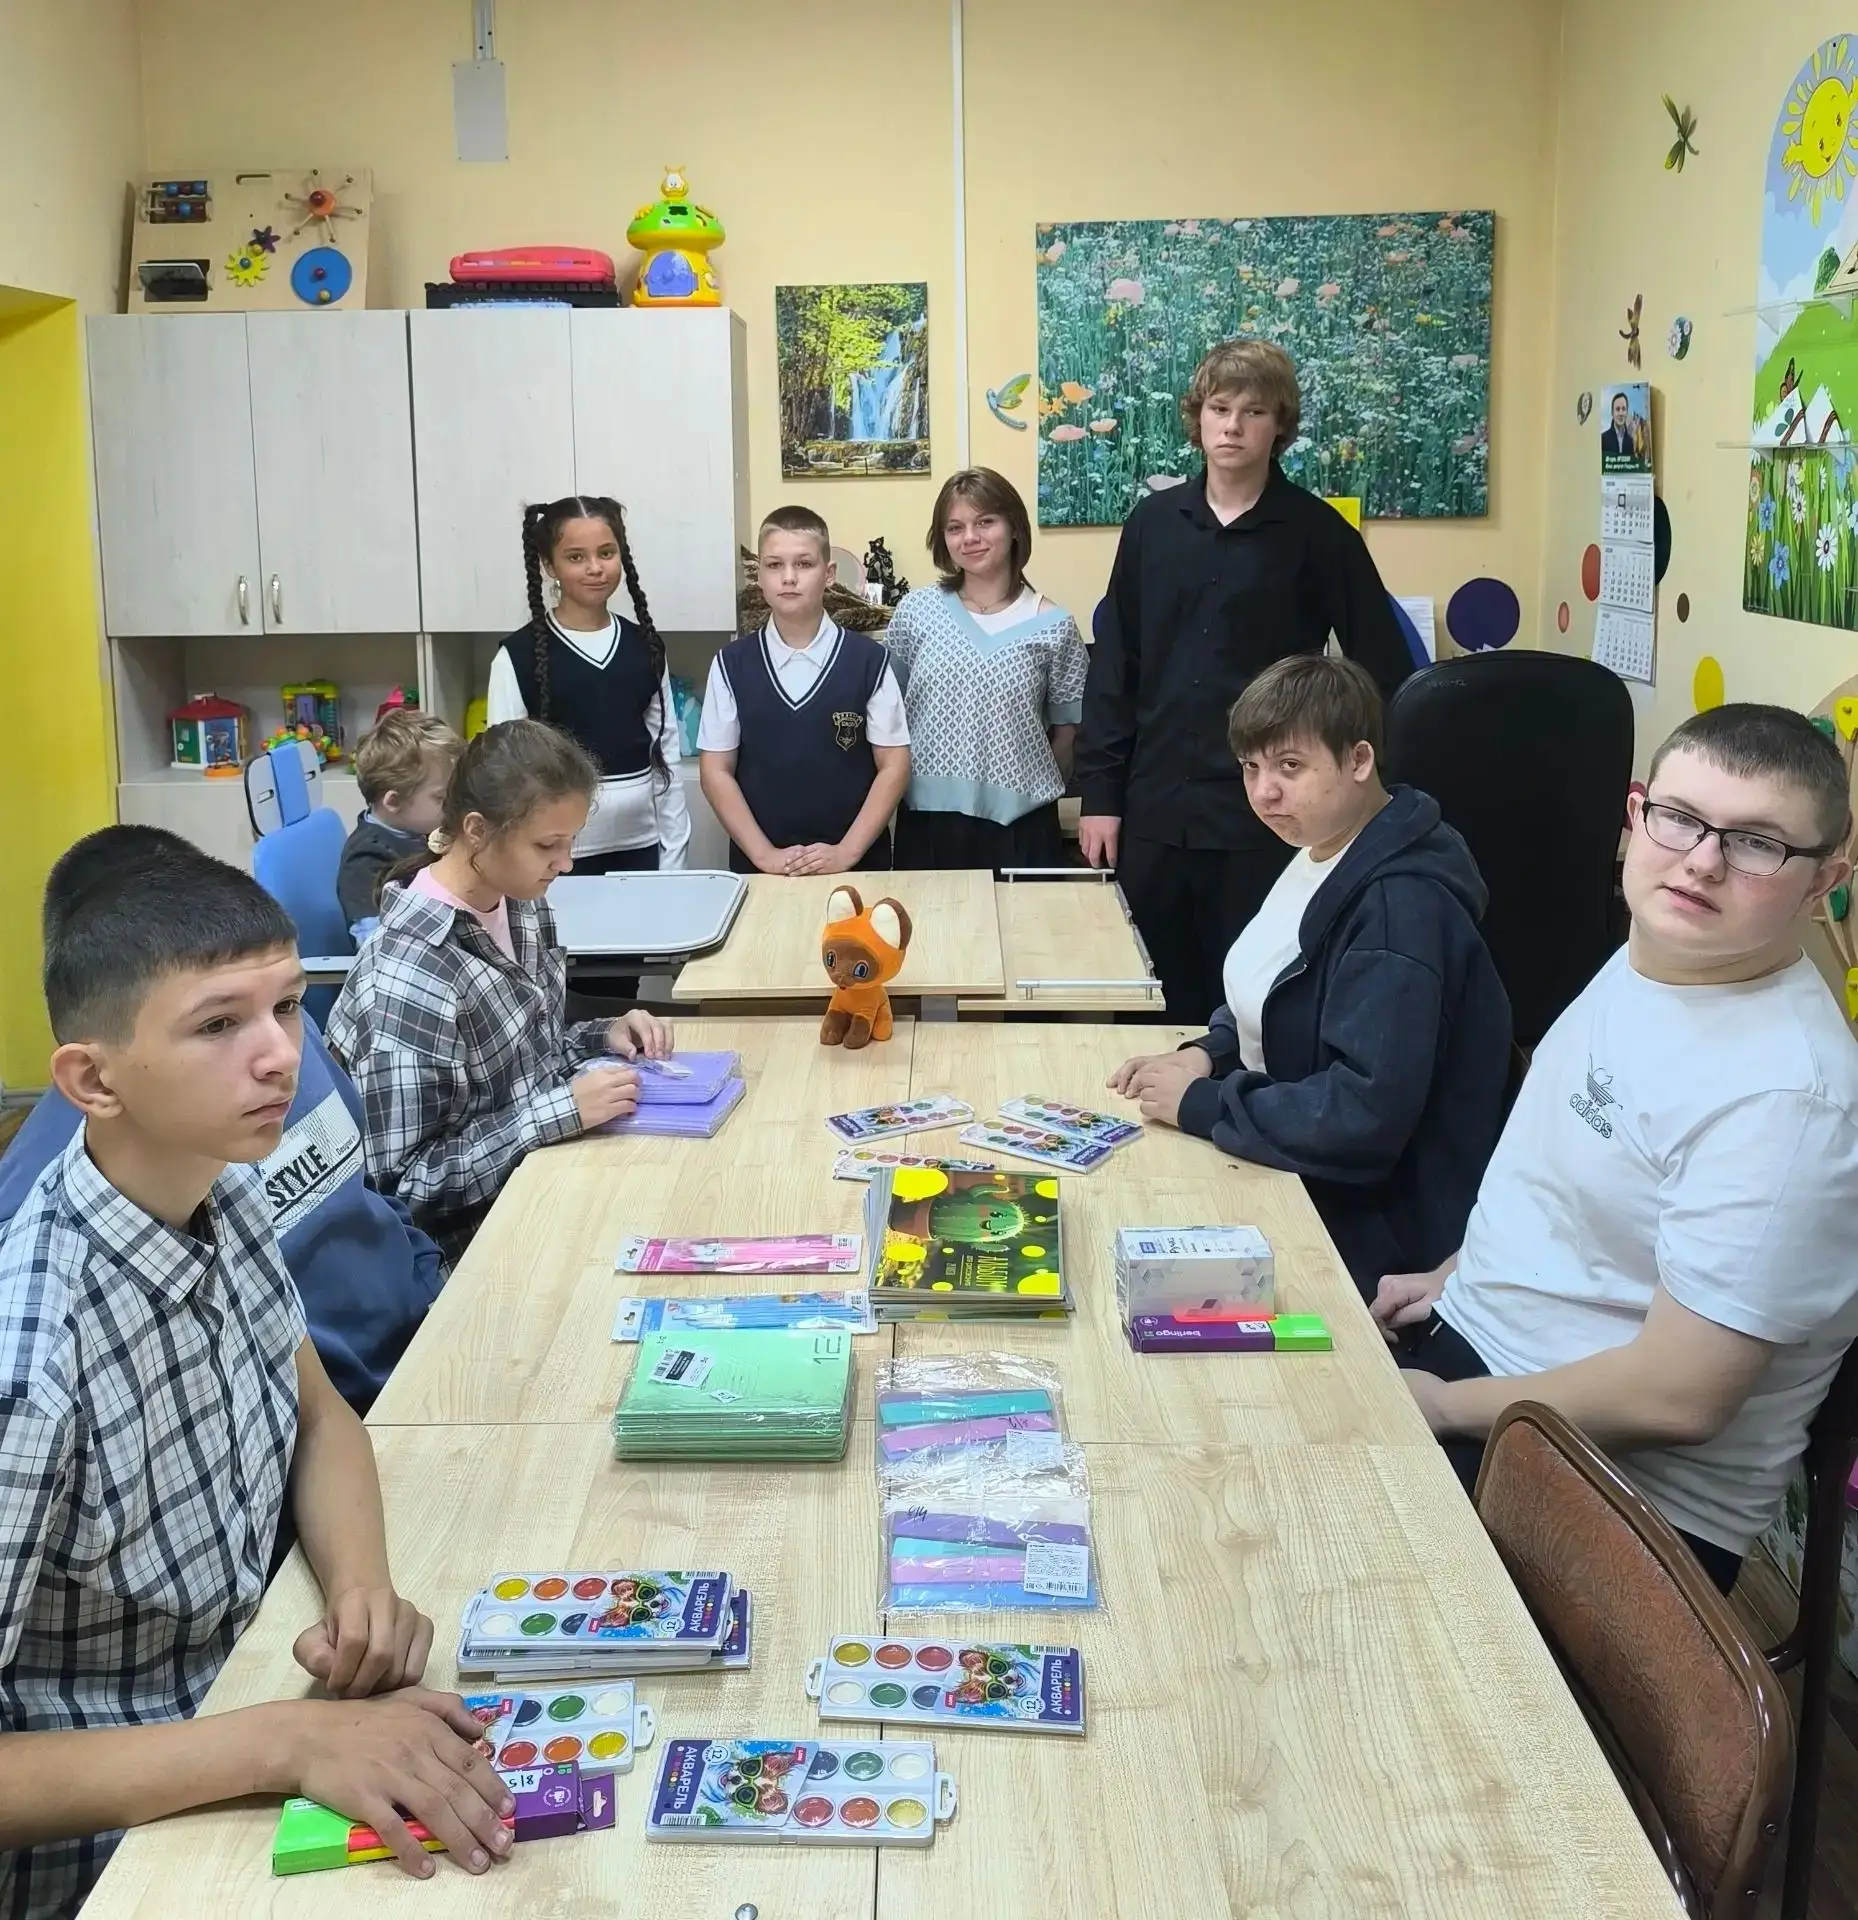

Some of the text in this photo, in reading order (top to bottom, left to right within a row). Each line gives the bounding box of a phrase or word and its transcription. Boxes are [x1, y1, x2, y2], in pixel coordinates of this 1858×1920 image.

[1570, 1093, 1613, 1139] adidas
[265, 1144, 328, 1209] STYLE
[1155, 1329, 1202, 1338] berlingo
[666, 1620, 677, 1630] 12
[689, 1582, 710, 1632] АКВАРЕЛЬ
[1026, 1699, 1036, 1711] 12
[1050, 1658, 1064, 1715] АКВАРЕЛЬ
[711, 1749, 722, 1760] 12
[673, 1746, 696, 1810] АКВАРЕЛЬ
